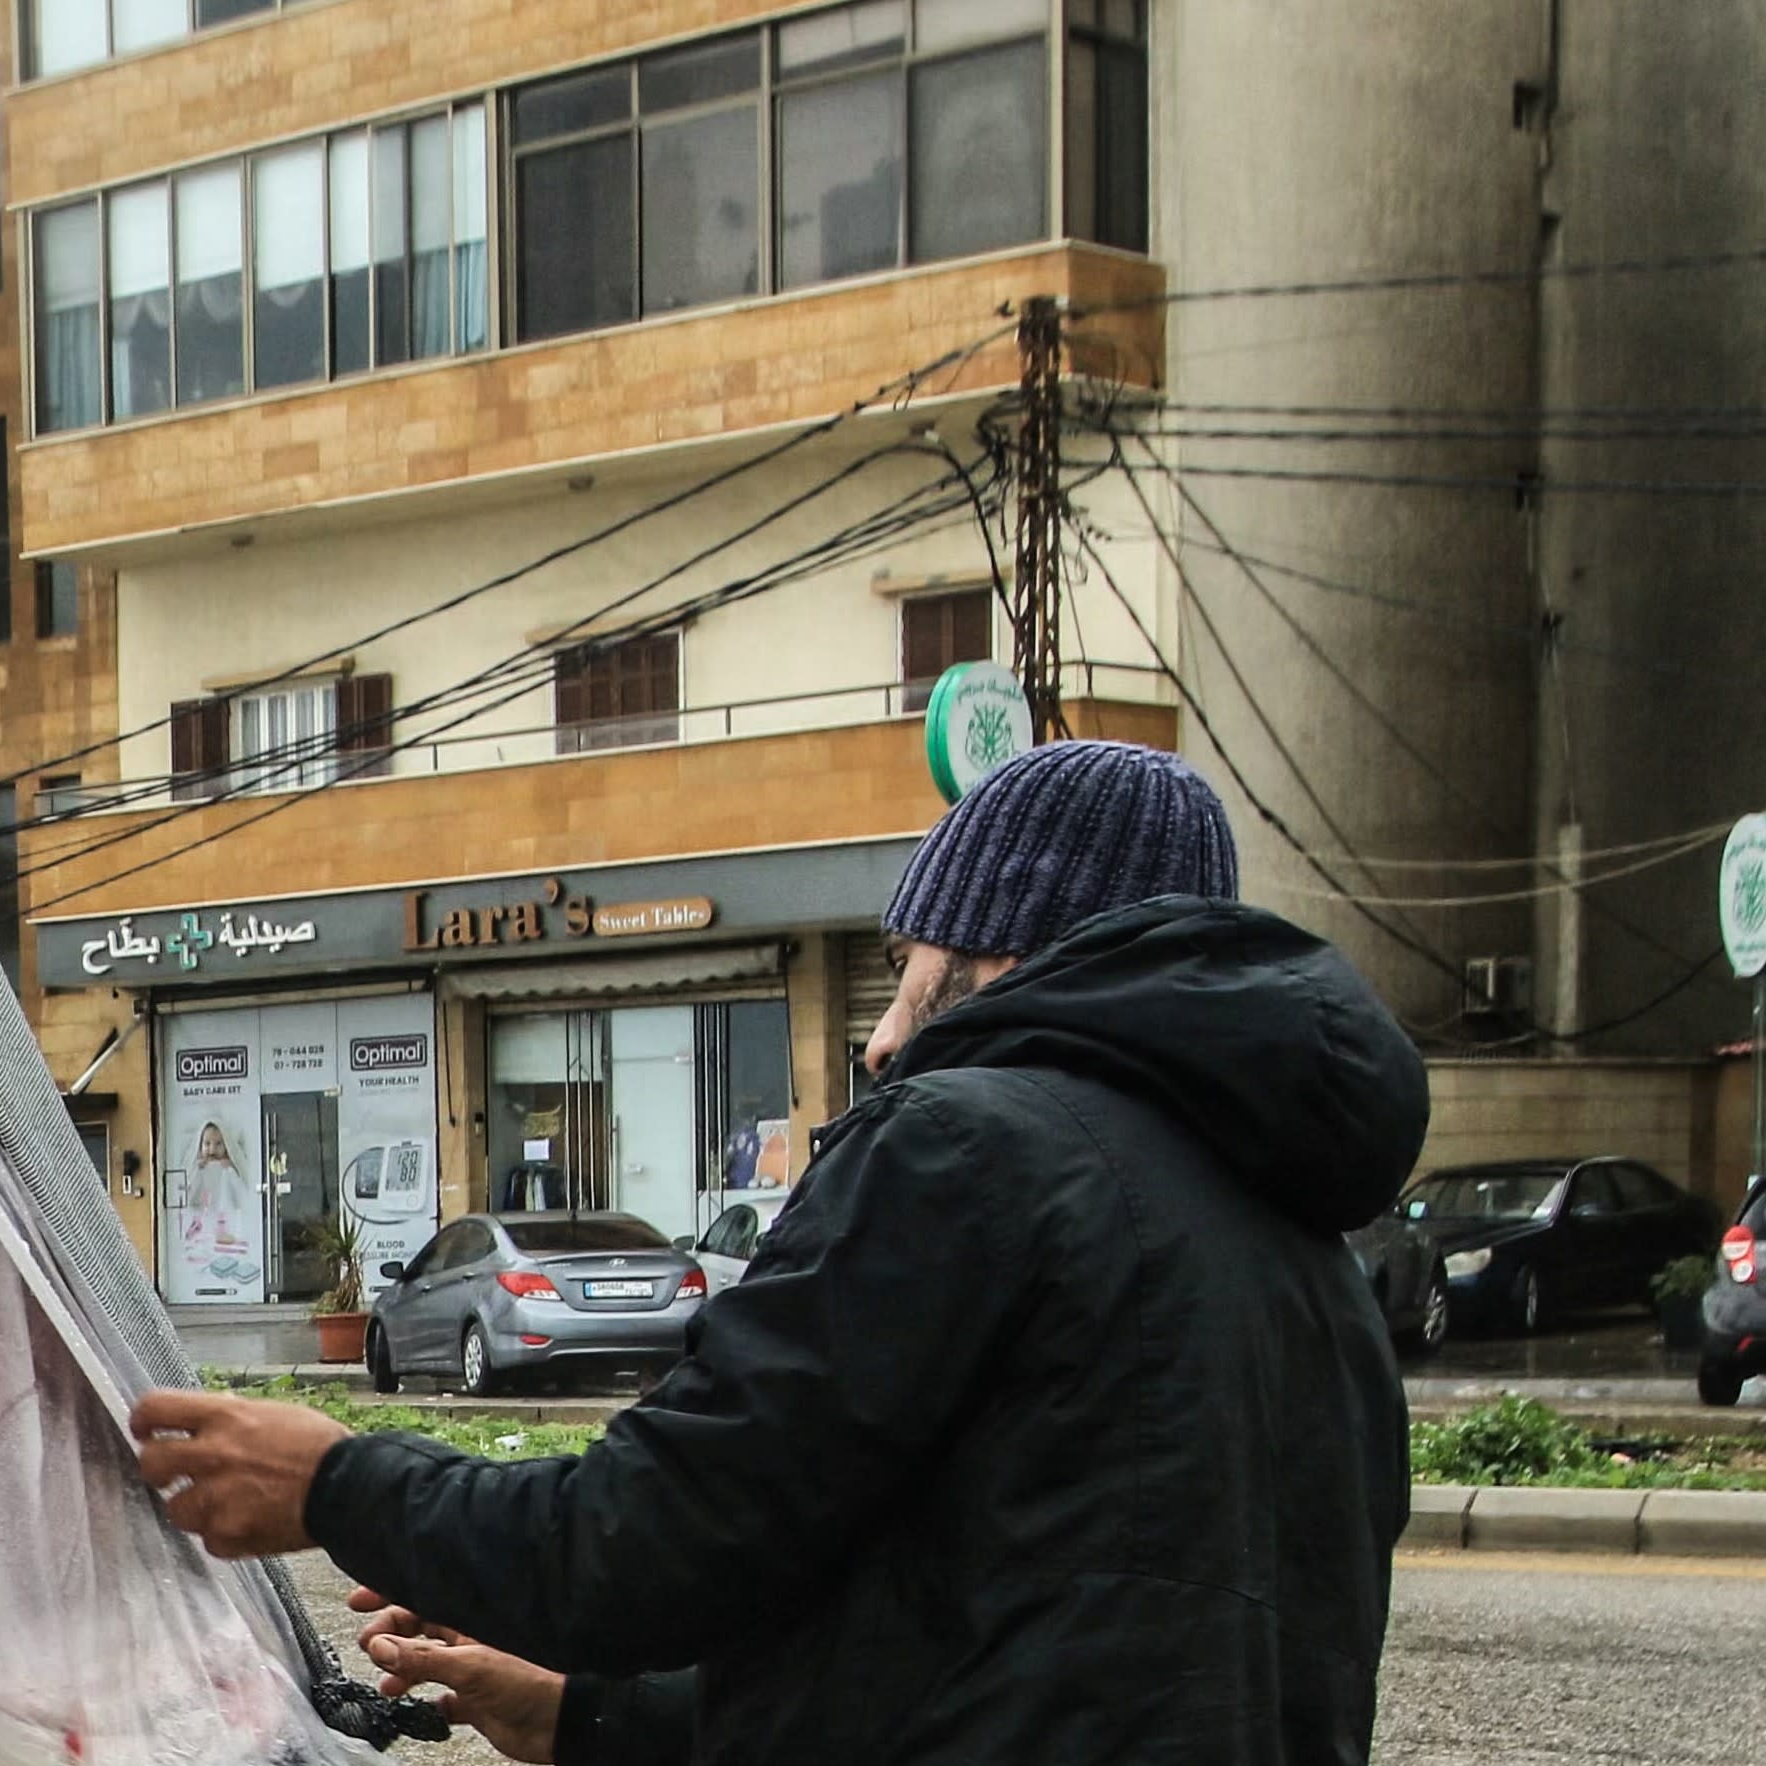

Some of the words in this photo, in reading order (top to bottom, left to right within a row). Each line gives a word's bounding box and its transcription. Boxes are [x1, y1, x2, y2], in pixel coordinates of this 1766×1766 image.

[401, 877, 590, 949] Lara's
[599, 911, 646, 930] Sweet
[219, 912, 316, 957] صيدلية
[354, 1041, 421, 1067] Optimal
[180, 1053, 243, 1077] Optimal
[359, 1077, 384, 1088] YOUR
[384, 1075, 420, 1086] HEALTH
[399, 1166, 417, 1182] 80
[377, 1240, 405, 1249] BLOOD
